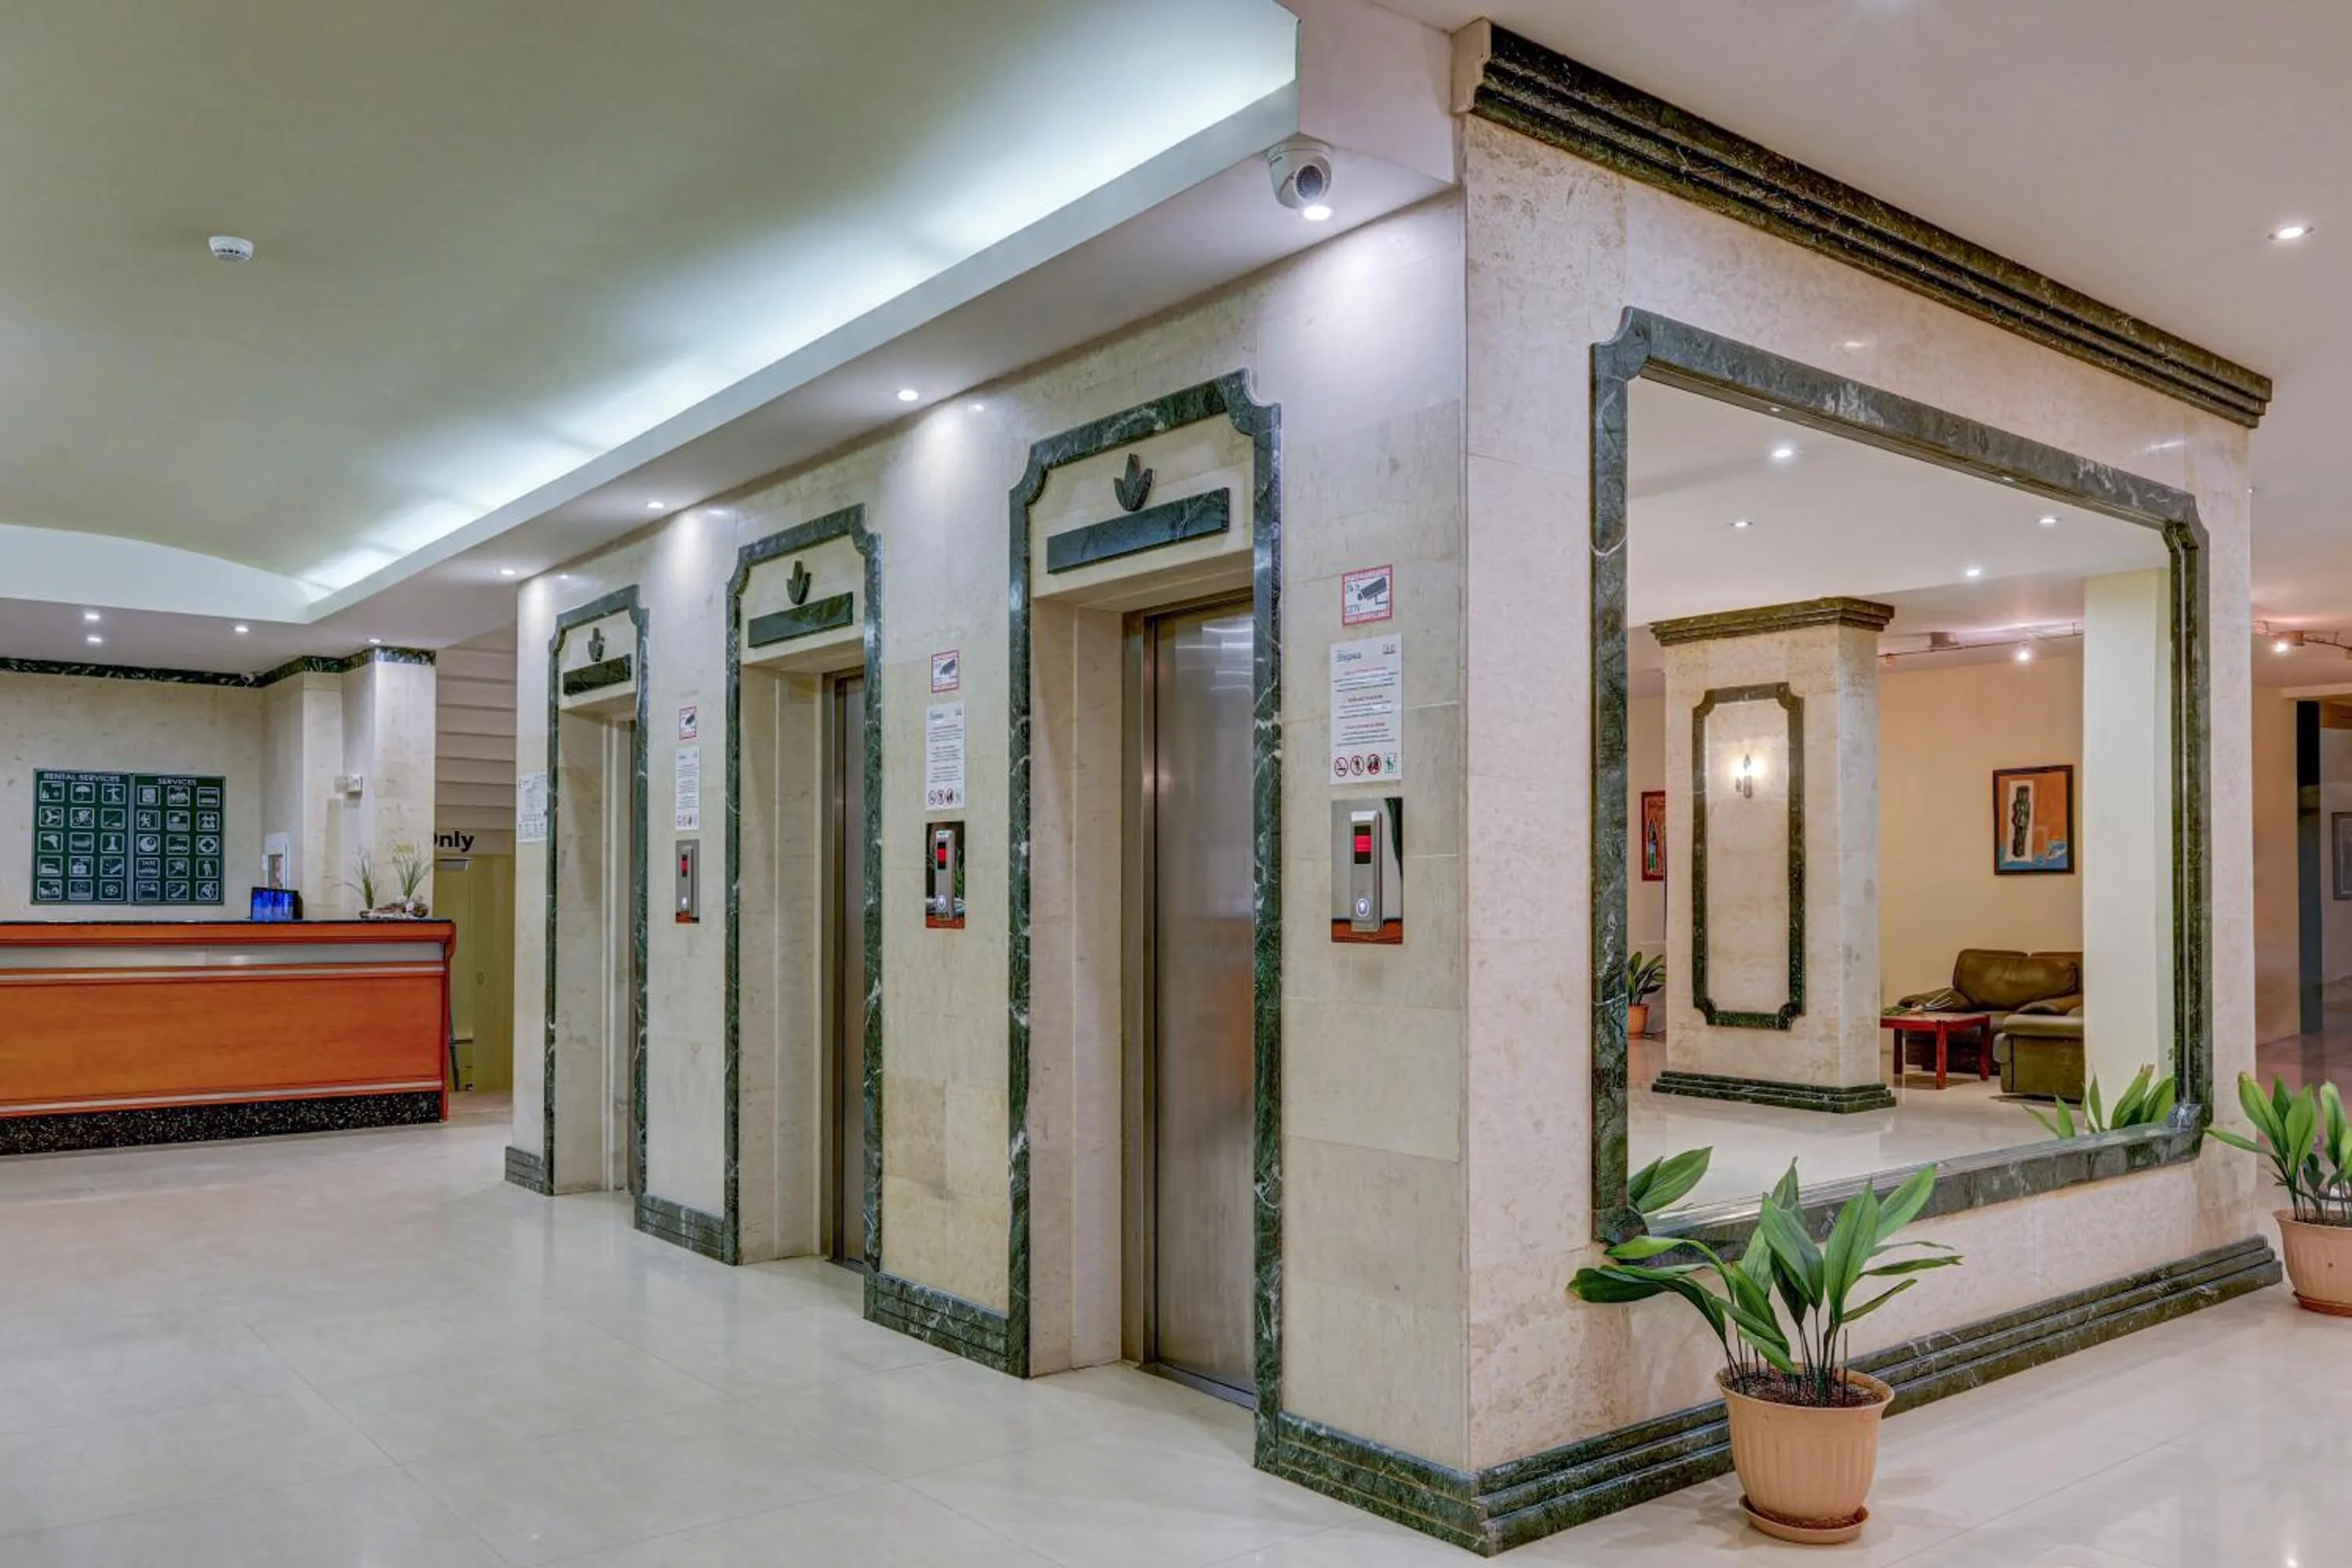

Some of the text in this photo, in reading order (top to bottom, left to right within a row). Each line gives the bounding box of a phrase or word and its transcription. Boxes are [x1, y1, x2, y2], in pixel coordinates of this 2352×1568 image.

[43, 772, 121, 782] RENTAL SERVICES
[158, 777, 197, 786] SERVICES
